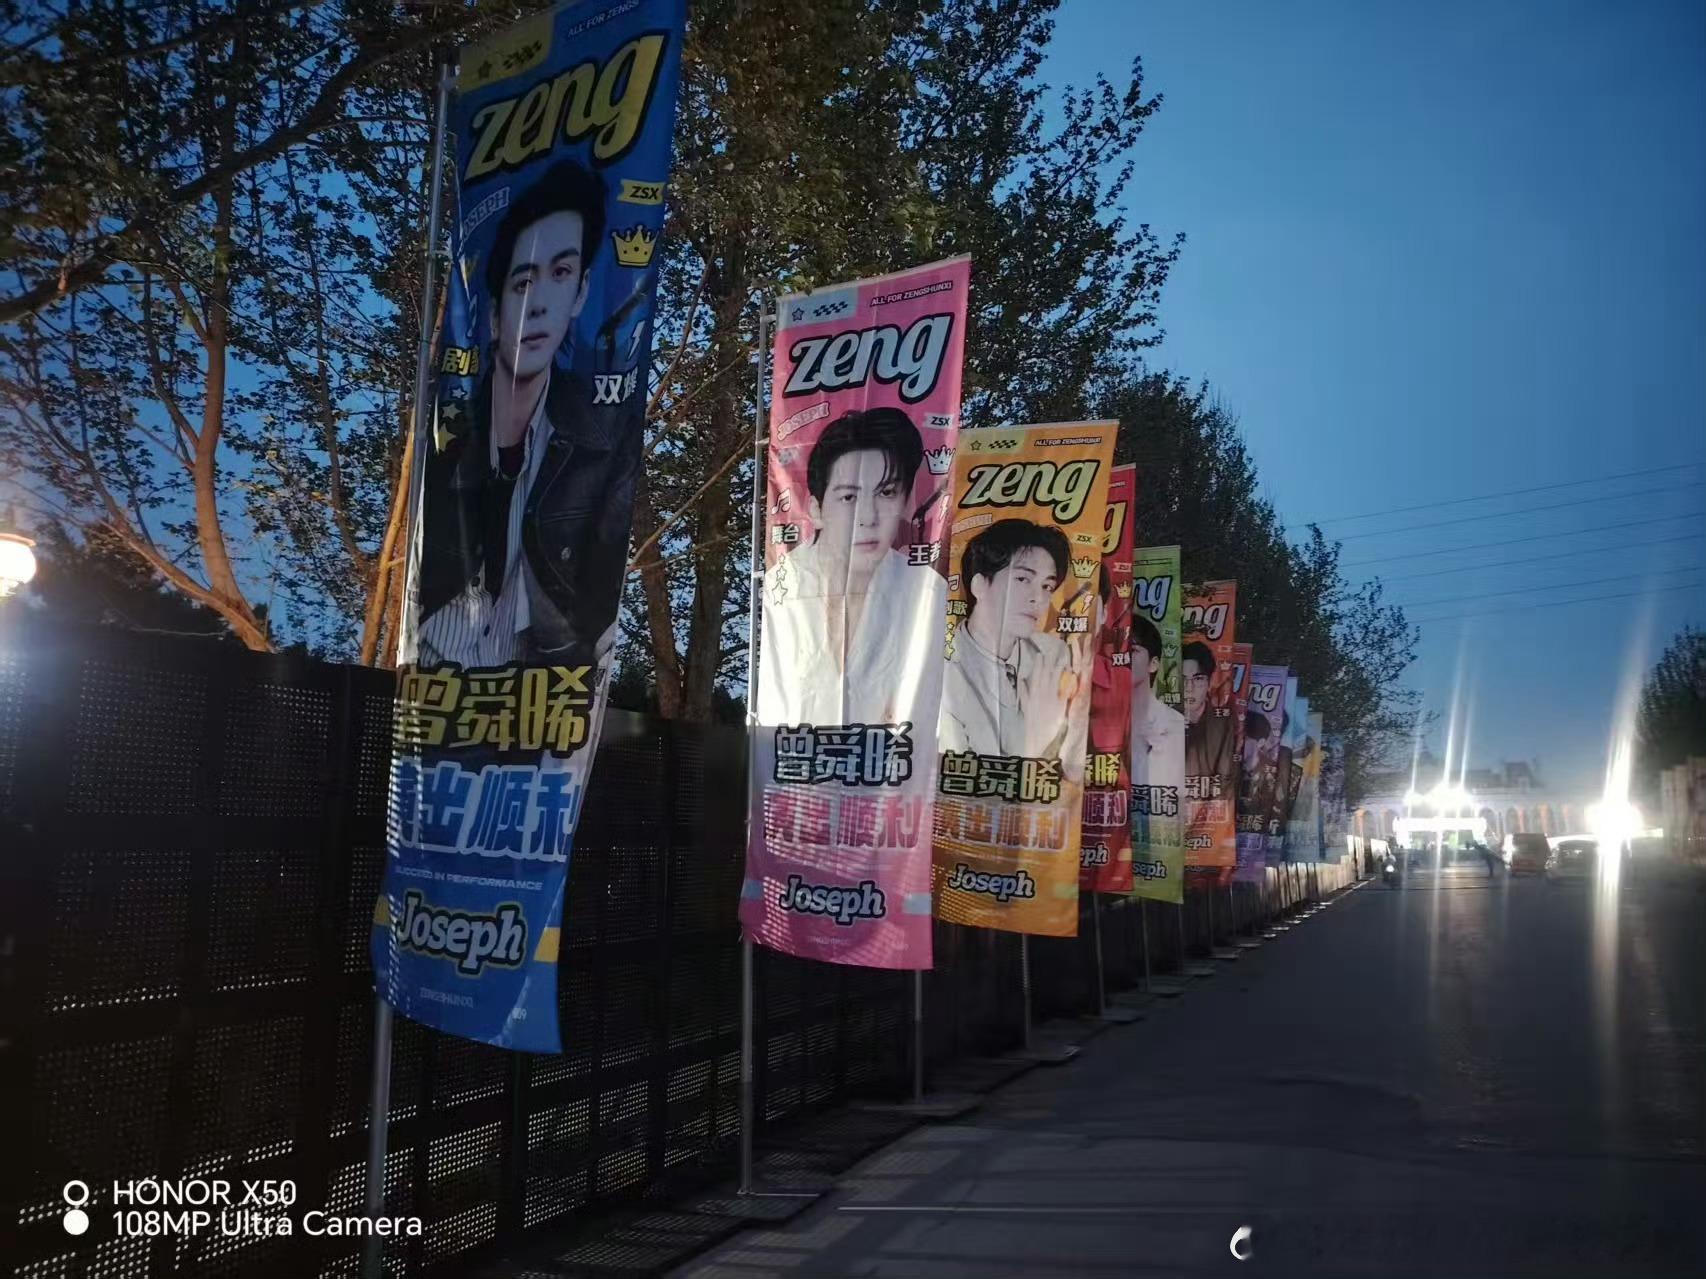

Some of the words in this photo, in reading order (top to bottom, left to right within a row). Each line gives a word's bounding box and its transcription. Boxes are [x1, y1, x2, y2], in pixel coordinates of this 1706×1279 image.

[462, 32, 667, 184] zeng
[630, 185, 659, 201] ZSX
[871, 296, 886, 306] ALL
[887, 293, 903, 303] FOR
[784, 315, 953, 402] zeng
[930, 416, 950, 426] ZSX
[959, 461, 1100, 522] zeng
[910, 544, 941, 565] 王者
[1077, 534, 1092, 543] ZSX
[399, 665, 593, 752] 曾舜晞
[776, 725, 911, 784] 曾舜晞
[943, 751, 1061, 802] 曾舜晞
[780, 876, 884, 924] Joseph
[949, 864, 1034, 901] Joseph
[397, 894, 526, 971] Joseph
